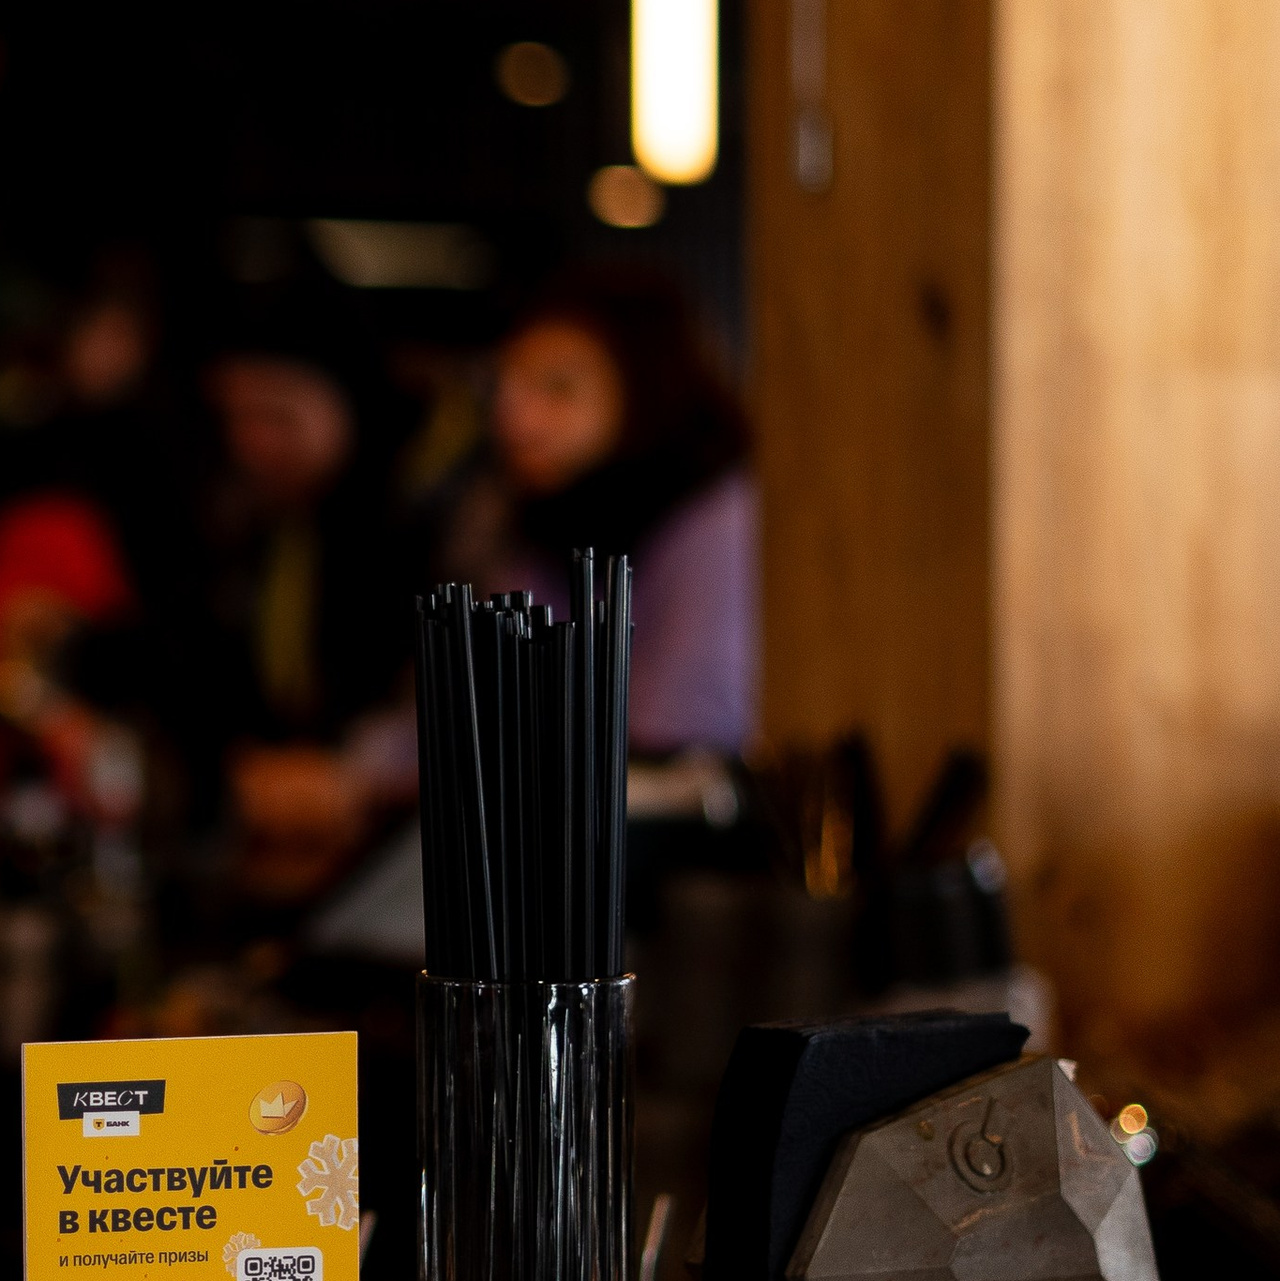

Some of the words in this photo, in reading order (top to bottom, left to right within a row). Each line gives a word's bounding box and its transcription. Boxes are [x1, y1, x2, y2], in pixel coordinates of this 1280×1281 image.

[73, 1090, 149, 1107] КВЕСТ
[56, 1159, 273, 1198] Участвуйте
[59, 1210, 80, 1234] в
[89, 1204, 217, 1233] квесте
[59, 1255, 69, 1267] и
[73, 1251, 155, 1269] получайте
[158, 1250, 209, 1266] призы
